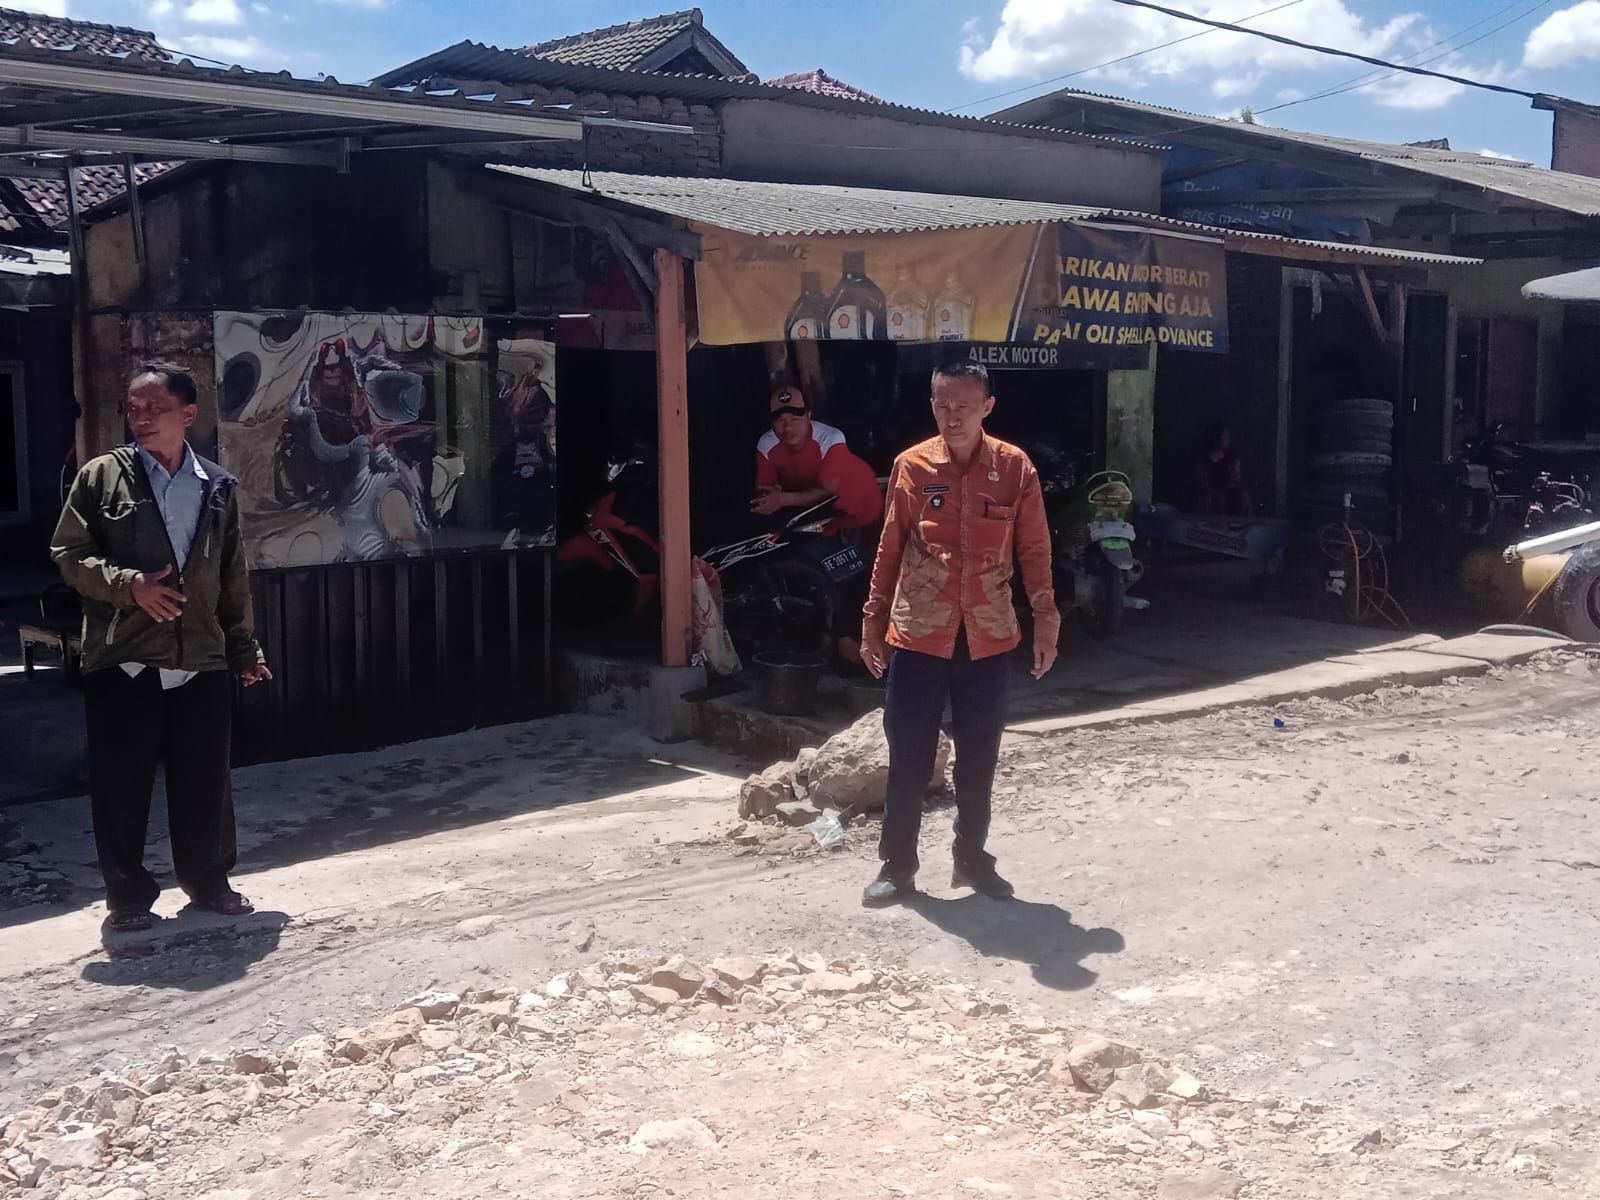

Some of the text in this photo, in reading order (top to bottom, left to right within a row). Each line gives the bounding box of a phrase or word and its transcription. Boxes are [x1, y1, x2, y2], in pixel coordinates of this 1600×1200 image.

[1180, 297, 1213, 317] AJA
[1086, 323, 1115, 345] OLI
[968, 346, 1059, 365] ALEX MOTOR
